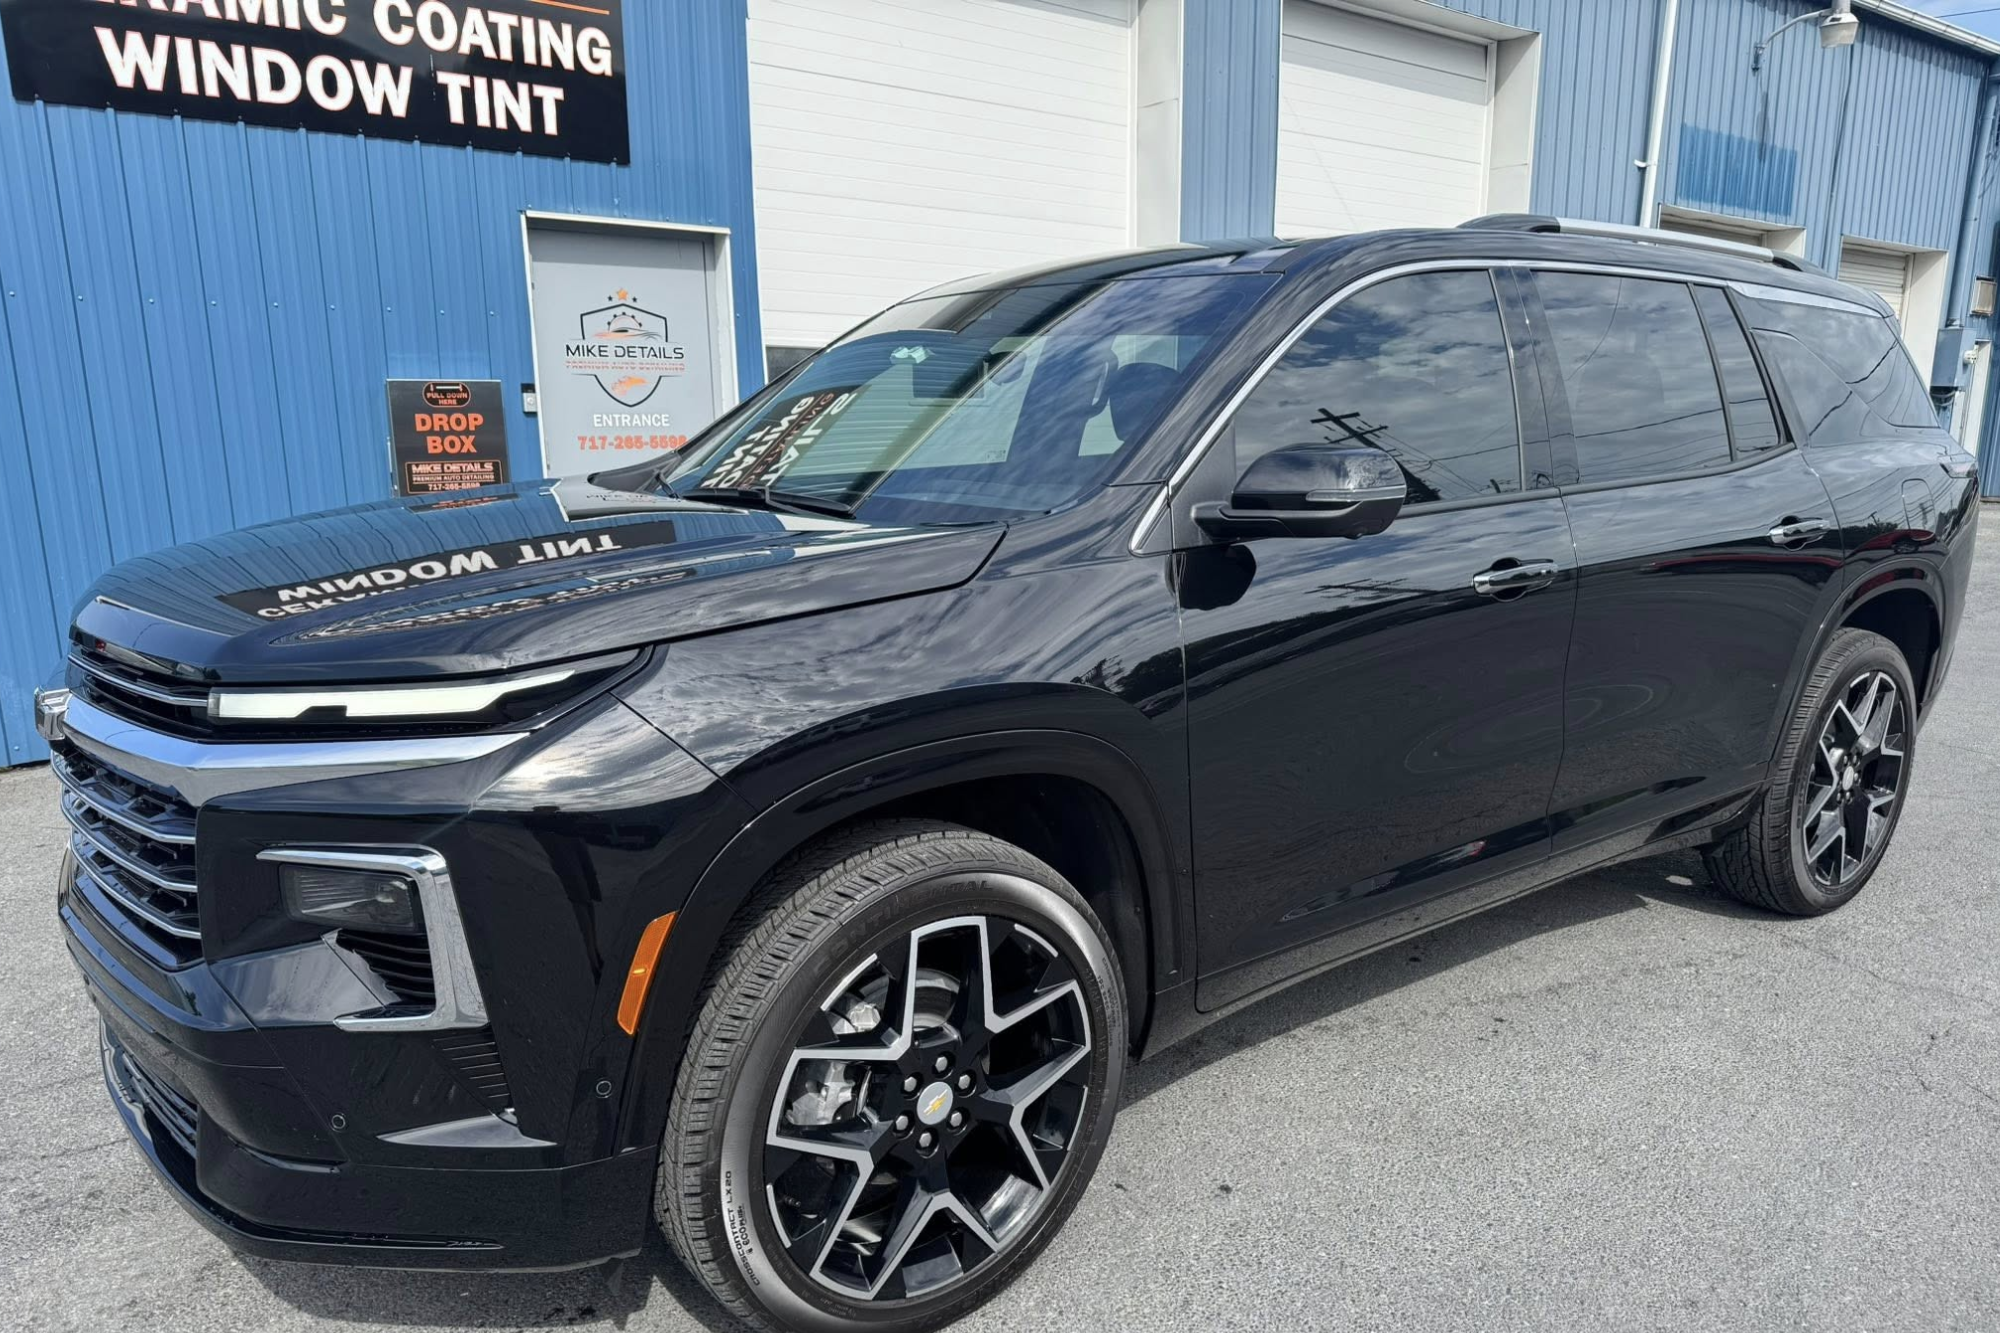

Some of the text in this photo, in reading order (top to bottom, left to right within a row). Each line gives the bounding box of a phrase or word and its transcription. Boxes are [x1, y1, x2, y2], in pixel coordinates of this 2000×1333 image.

[373, 0, 613, 77] COATING
[93, 26, 565, 136] WINDOW TINT
[565, 344, 685, 360] MIKE DETAILS
[415, 413, 484, 432] DROP
[593, 413, 670, 427] ENTRANCE
[426, 435, 477, 454] BOX
[411, 462, 494, 474] MIKE DETAILS
[727, 1207, 761, 1287] CROSSCONTACT
